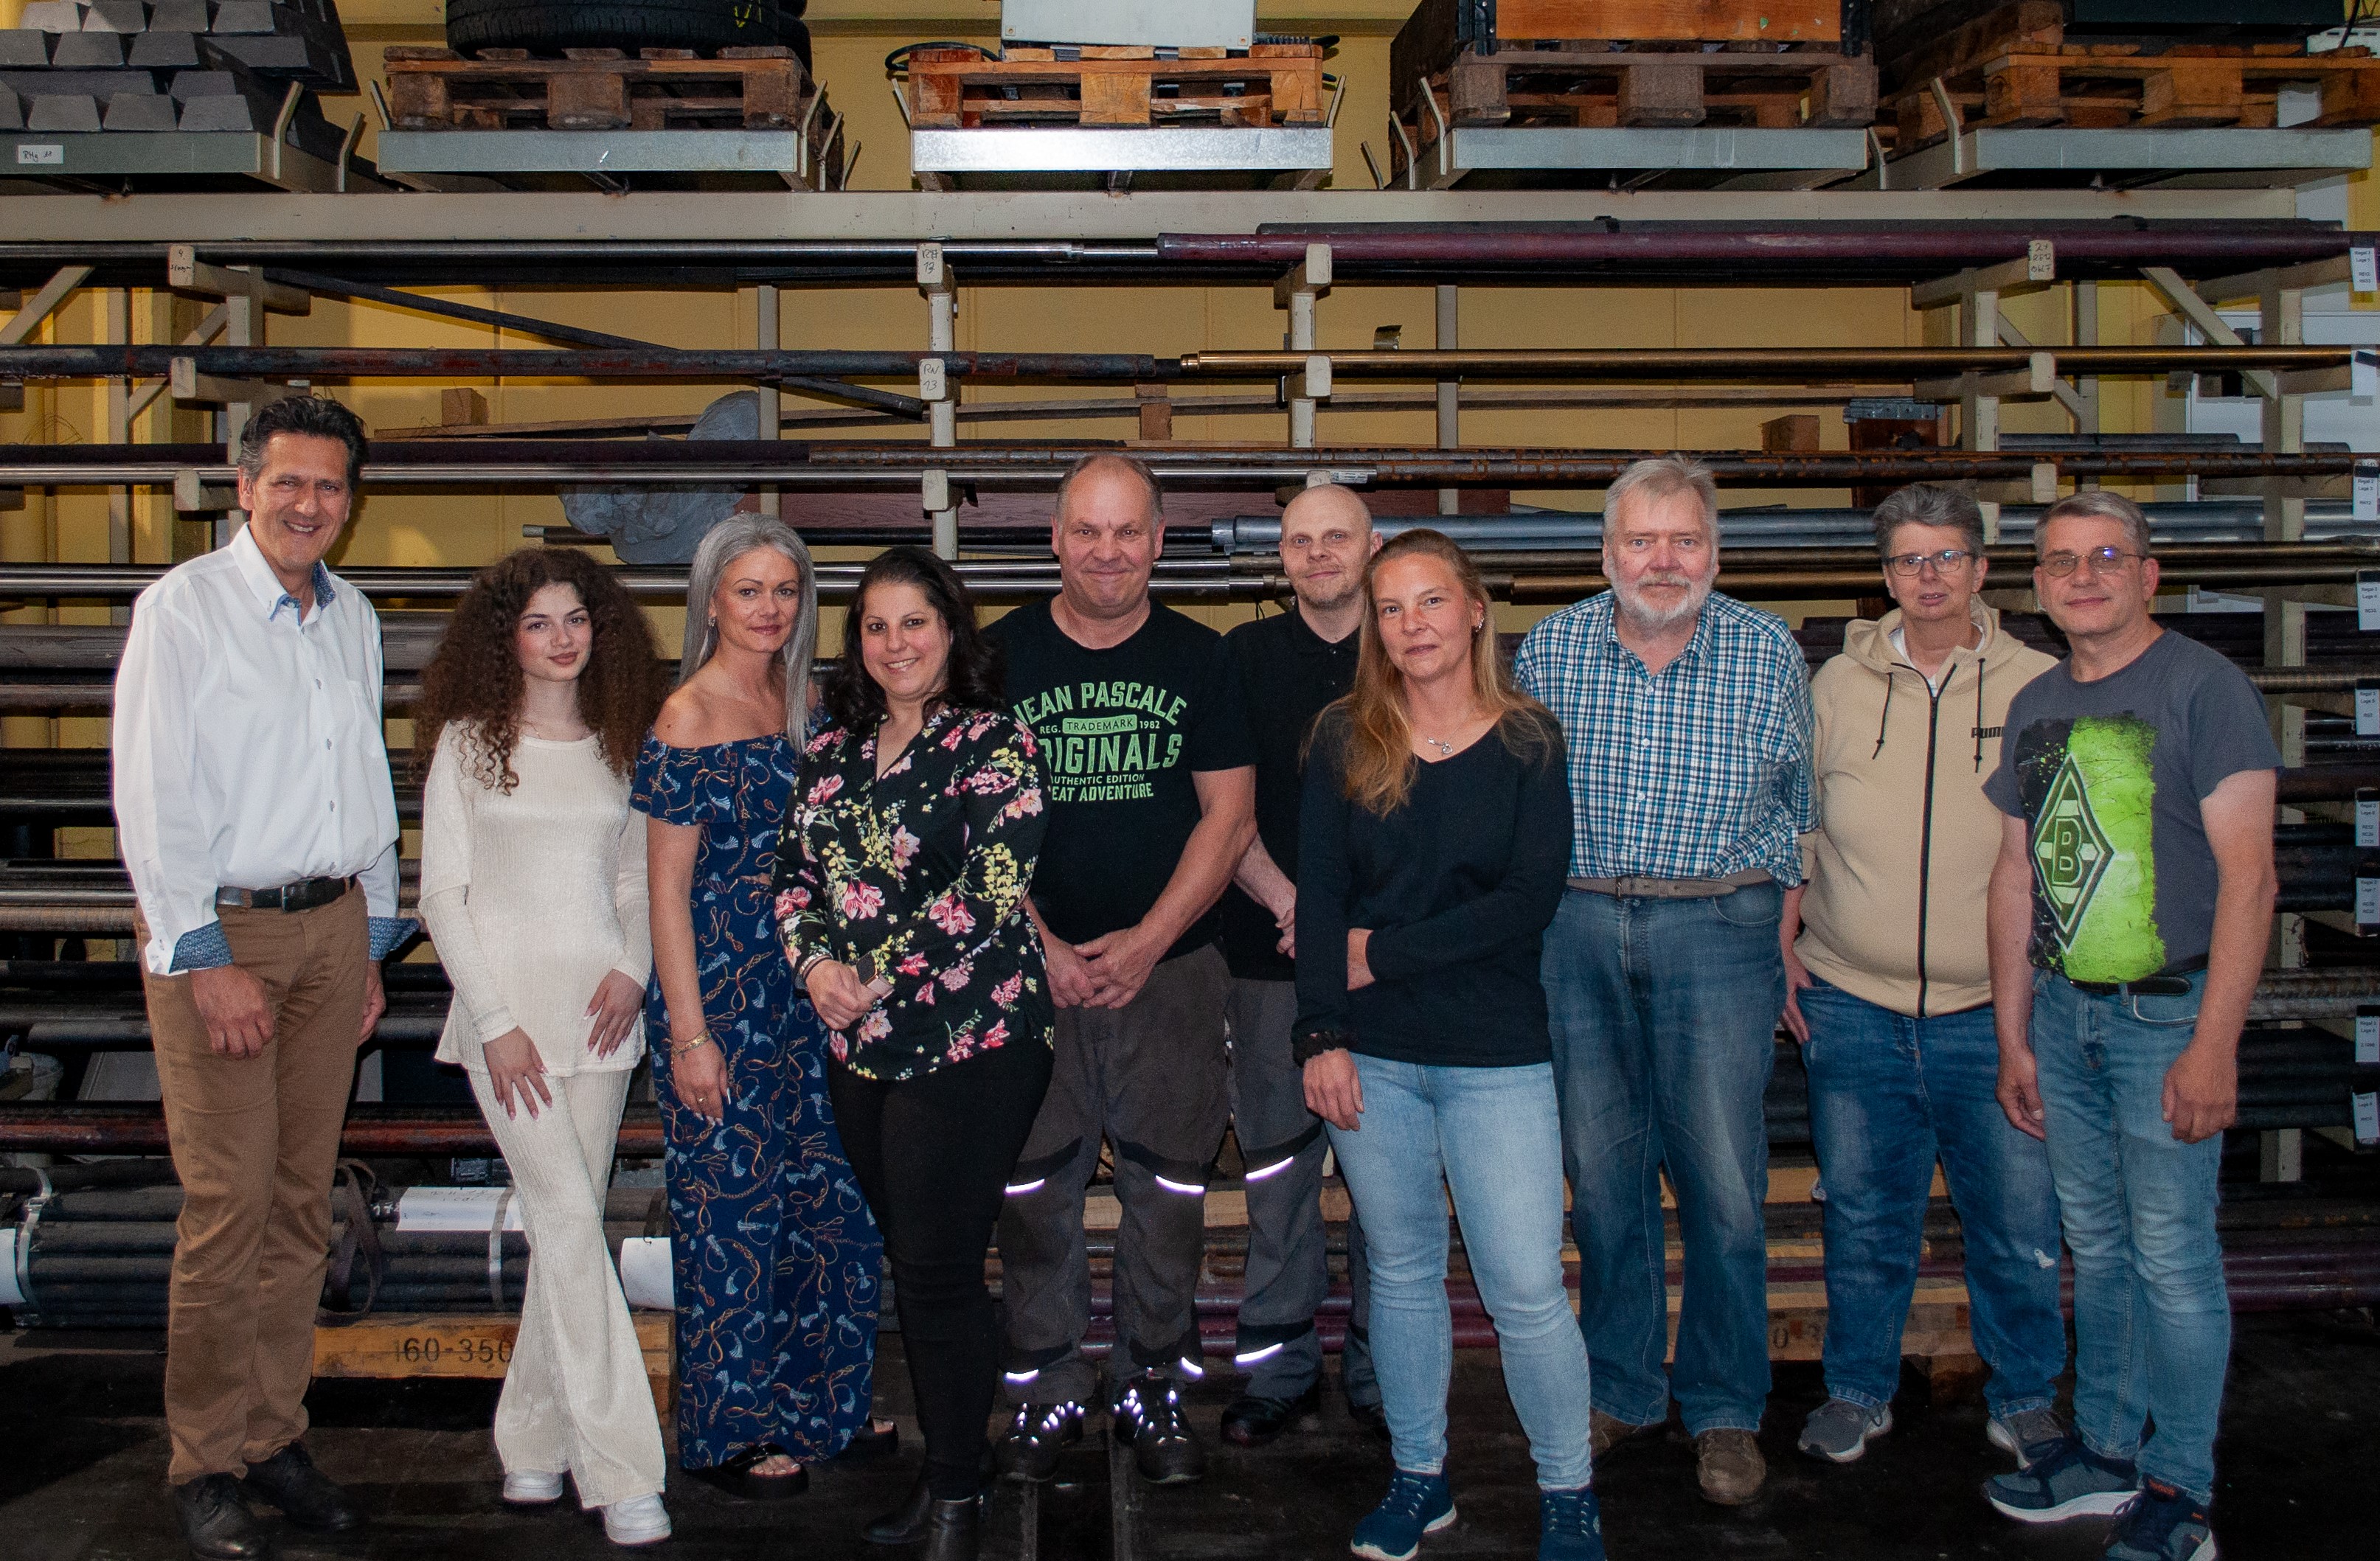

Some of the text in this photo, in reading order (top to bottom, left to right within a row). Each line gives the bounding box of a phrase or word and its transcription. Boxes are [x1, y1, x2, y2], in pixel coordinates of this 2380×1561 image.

[923, 380, 937, 392] 13
[1081, 681, 1187, 726] PASCALE
[1040, 724, 1061, 734] REG.
[1066, 718, 1133, 731] TRADEMARK
[1139, 720, 1160, 729] 1982
[1107, 774, 1145, 783] EDITION
[1079, 782, 1154, 802] ADVENTURE
[2053, 817, 2083, 886] B
